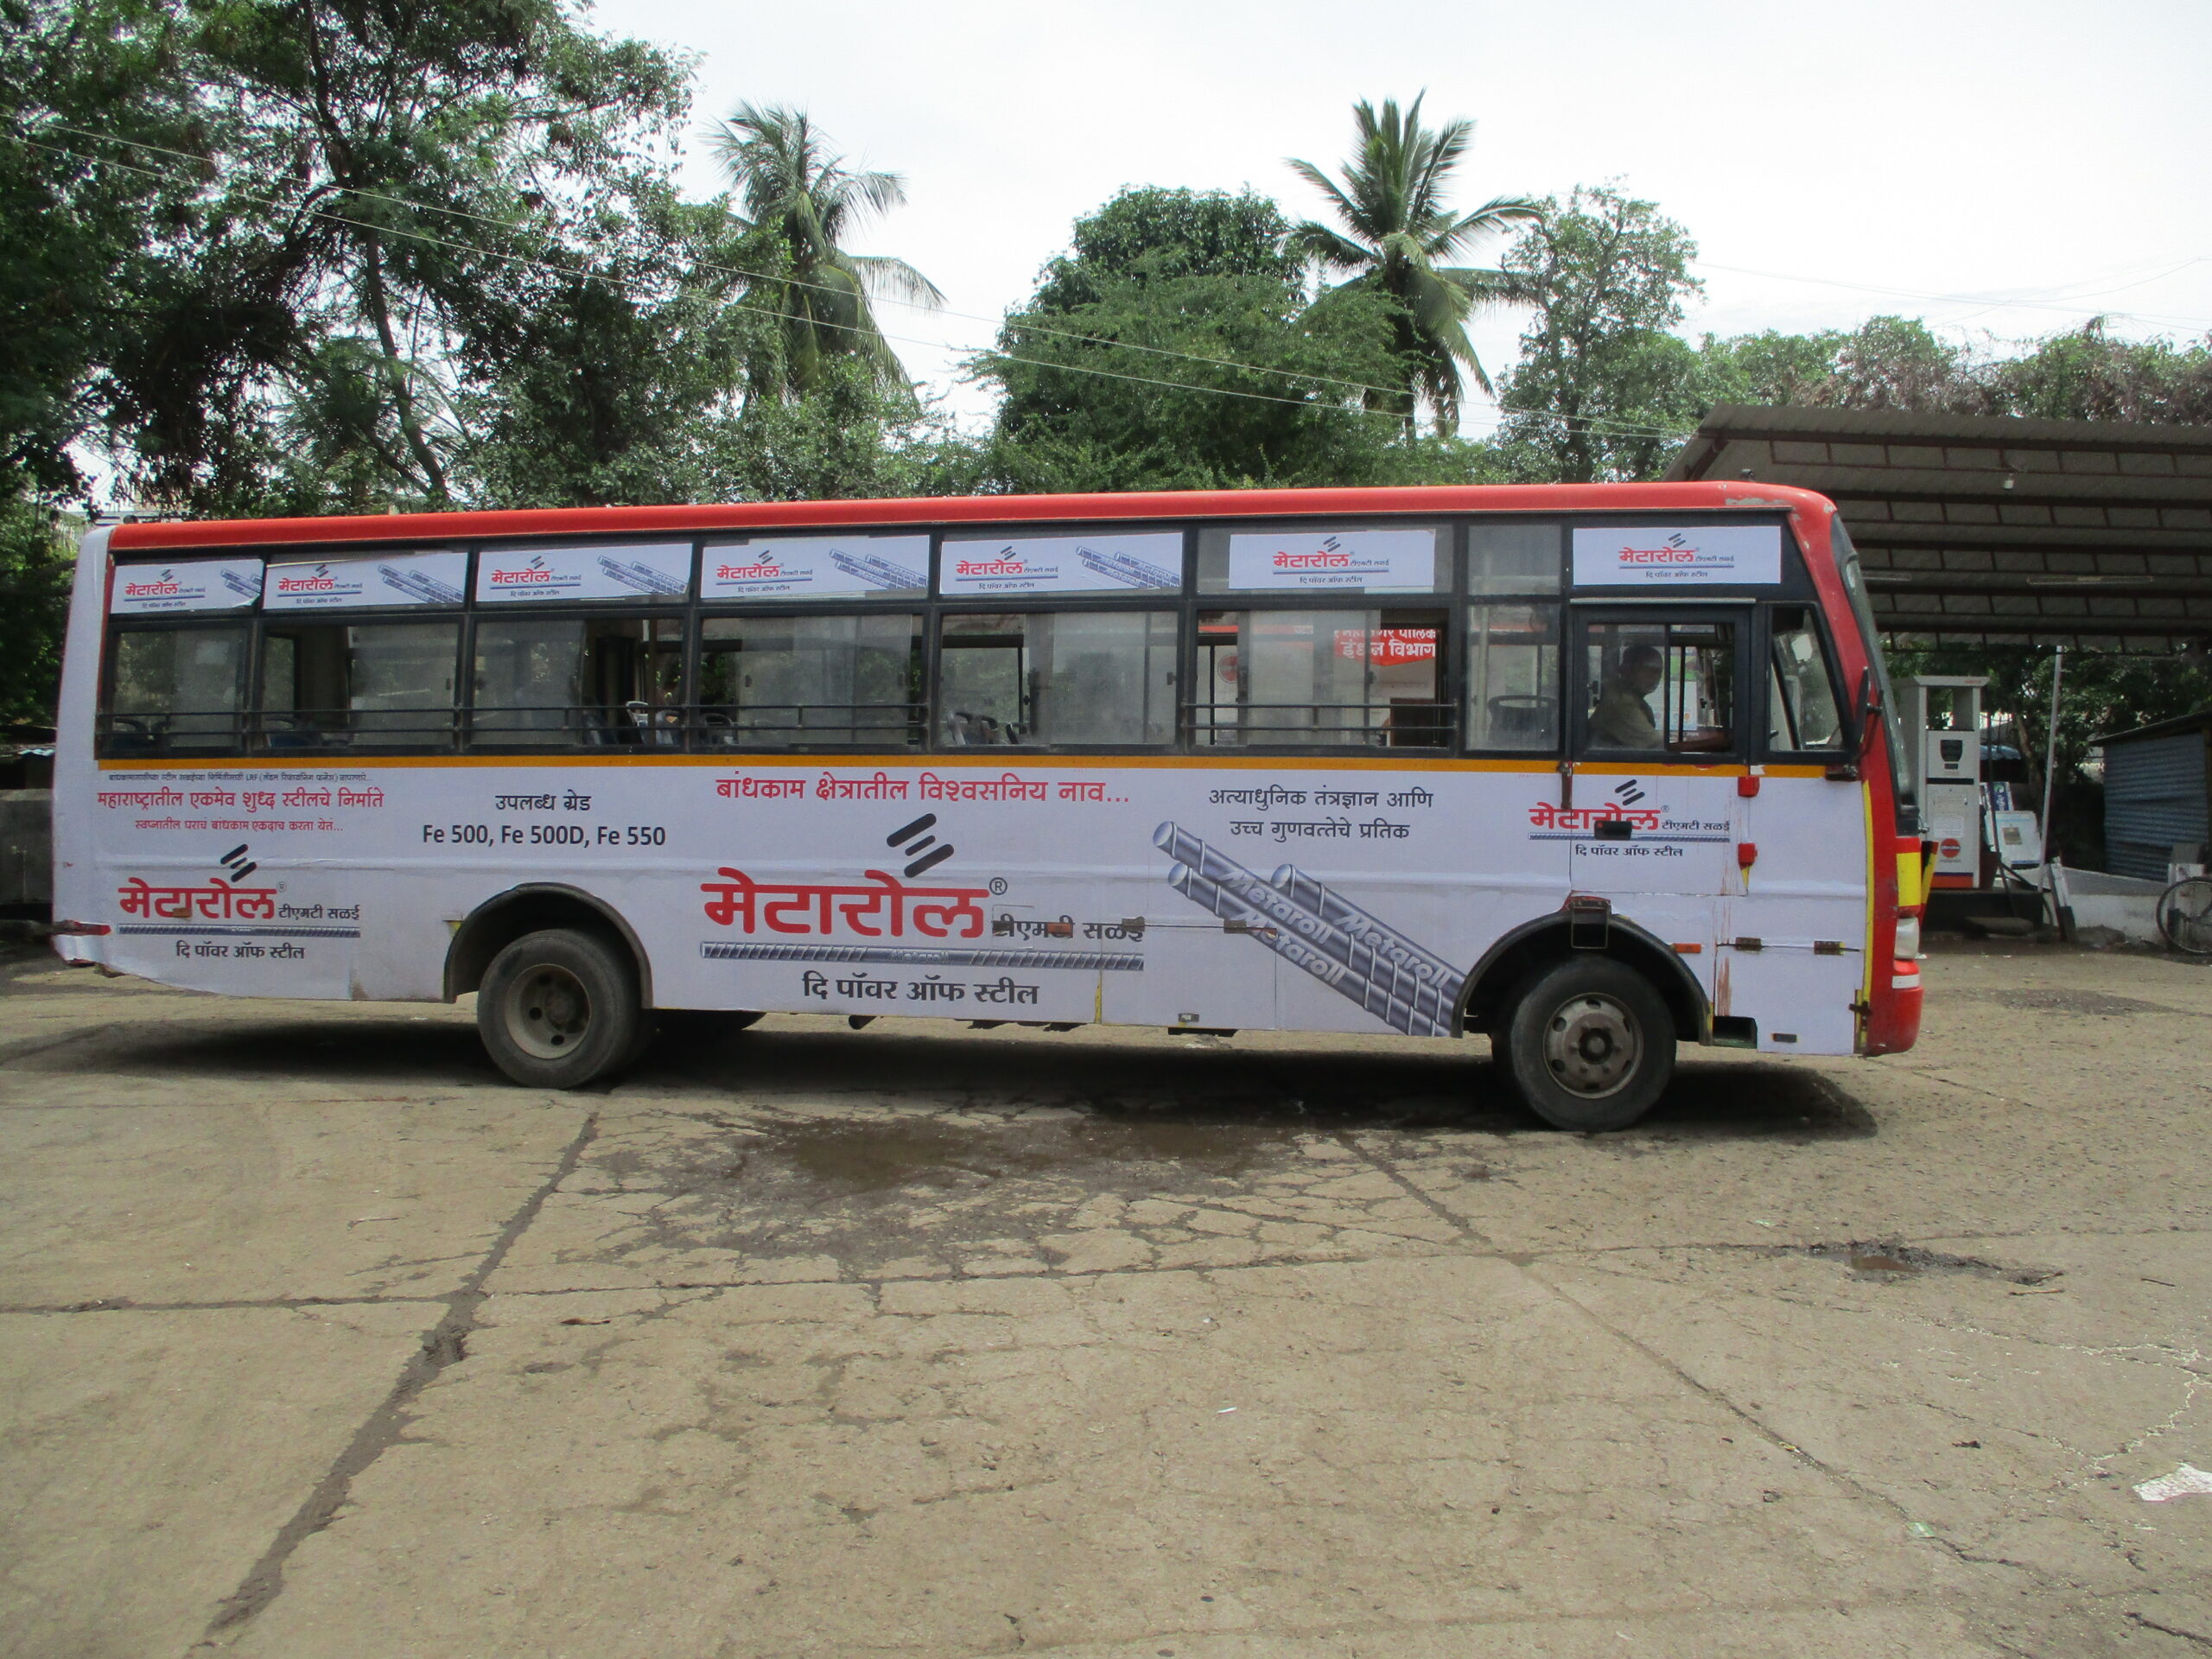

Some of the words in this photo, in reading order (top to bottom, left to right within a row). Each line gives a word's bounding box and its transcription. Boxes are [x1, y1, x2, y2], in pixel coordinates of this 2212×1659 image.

[1273, 550, 1350, 568] मेटारोल
[1618, 546, 1695, 563] मेटारोल
[492, 568, 551, 583] मेटारोल
[716, 563, 780, 580] मेटारोल
[956, 559, 1023, 575] मेटारोल
[125, 581, 179, 595] मेटारोल
[278, 576, 334, 591] मेटारोल
[1389, 639, 1435, 657] विभाग
[715, 771, 806, 799] बांधकाम
[816, 771, 910, 800] क्षेत्रातील
[918, 772, 1048, 802] विश्वसनिय
[1058, 781, 1129, 803] नाव...
[1209, 785, 1306, 810] अत्याधुनिक
[1314, 785, 1379, 809] तंत्रज्ञान
[1387, 786, 1433, 808] आणि
[97, 786, 183, 810] महाराष्ट्रातील
[189, 786, 236, 809] एकमेव
[242, 791, 276, 813] शुध्द
[282, 786, 331, 807] स्टीलचे
[338, 786, 385, 808] निर्माते
[495, 793, 556, 810] उपलब्ध
[563, 789, 592, 810] ग्रेड
[135, 817, 180, 830] स्वप्नातील
[211, 817, 249, 830] बांधकाम
[252, 821, 284, 832] एकदाच
[289, 821, 313, 830] करता
[1528, 802, 1661, 830] मेटारोल
[1662, 820, 1700, 831] टीएमटी
[1703, 820, 1730, 831] सळई
[423, 824, 445, 843] Fe
[451, 824, 494, 848] 500,
[501, 825, 524, 844] Fe
[531, 825, 589, 849] 500D,
[597, 826, 620, 845] Fe
[627, 826, 666, 846] 550
[1230, 821, 1264, 836] उच्च
[1271, 817, 1352, 843] गुणवत्तेचे
[1359, 817, 1410, 839] प्रतिक
[1575, 844, 1586, 856] दि
[1591, 843, 1618, 855] पॉवर
[1623, 843, 1649, 856] ऑफ
[1654, 844, 1683, 856] स्टील
[118, 877, 276, 919] मेटारोल
[279, 905, 323, 922] टीएमटी
[327, 905, 359, 921] सळई
[700, 867, 989, 938] मेटारोल
[1219, 869, 1334, 945] Metaroll
[175, 940, 191, 958] दि
[195, 939, 228, 958] पॉवर
[233, 939, 265, 959] ऑफ
[270, 941, 304, 960] स्टील
[1332, 913, 1452, 988] Metaroll
[803, 970, 829, 1000] दि
[836, 972, 898, 1001] पॉवर
[906, 974, 965, 1001] ऑफ
[975, 976, 1039, 1005] स्टील
